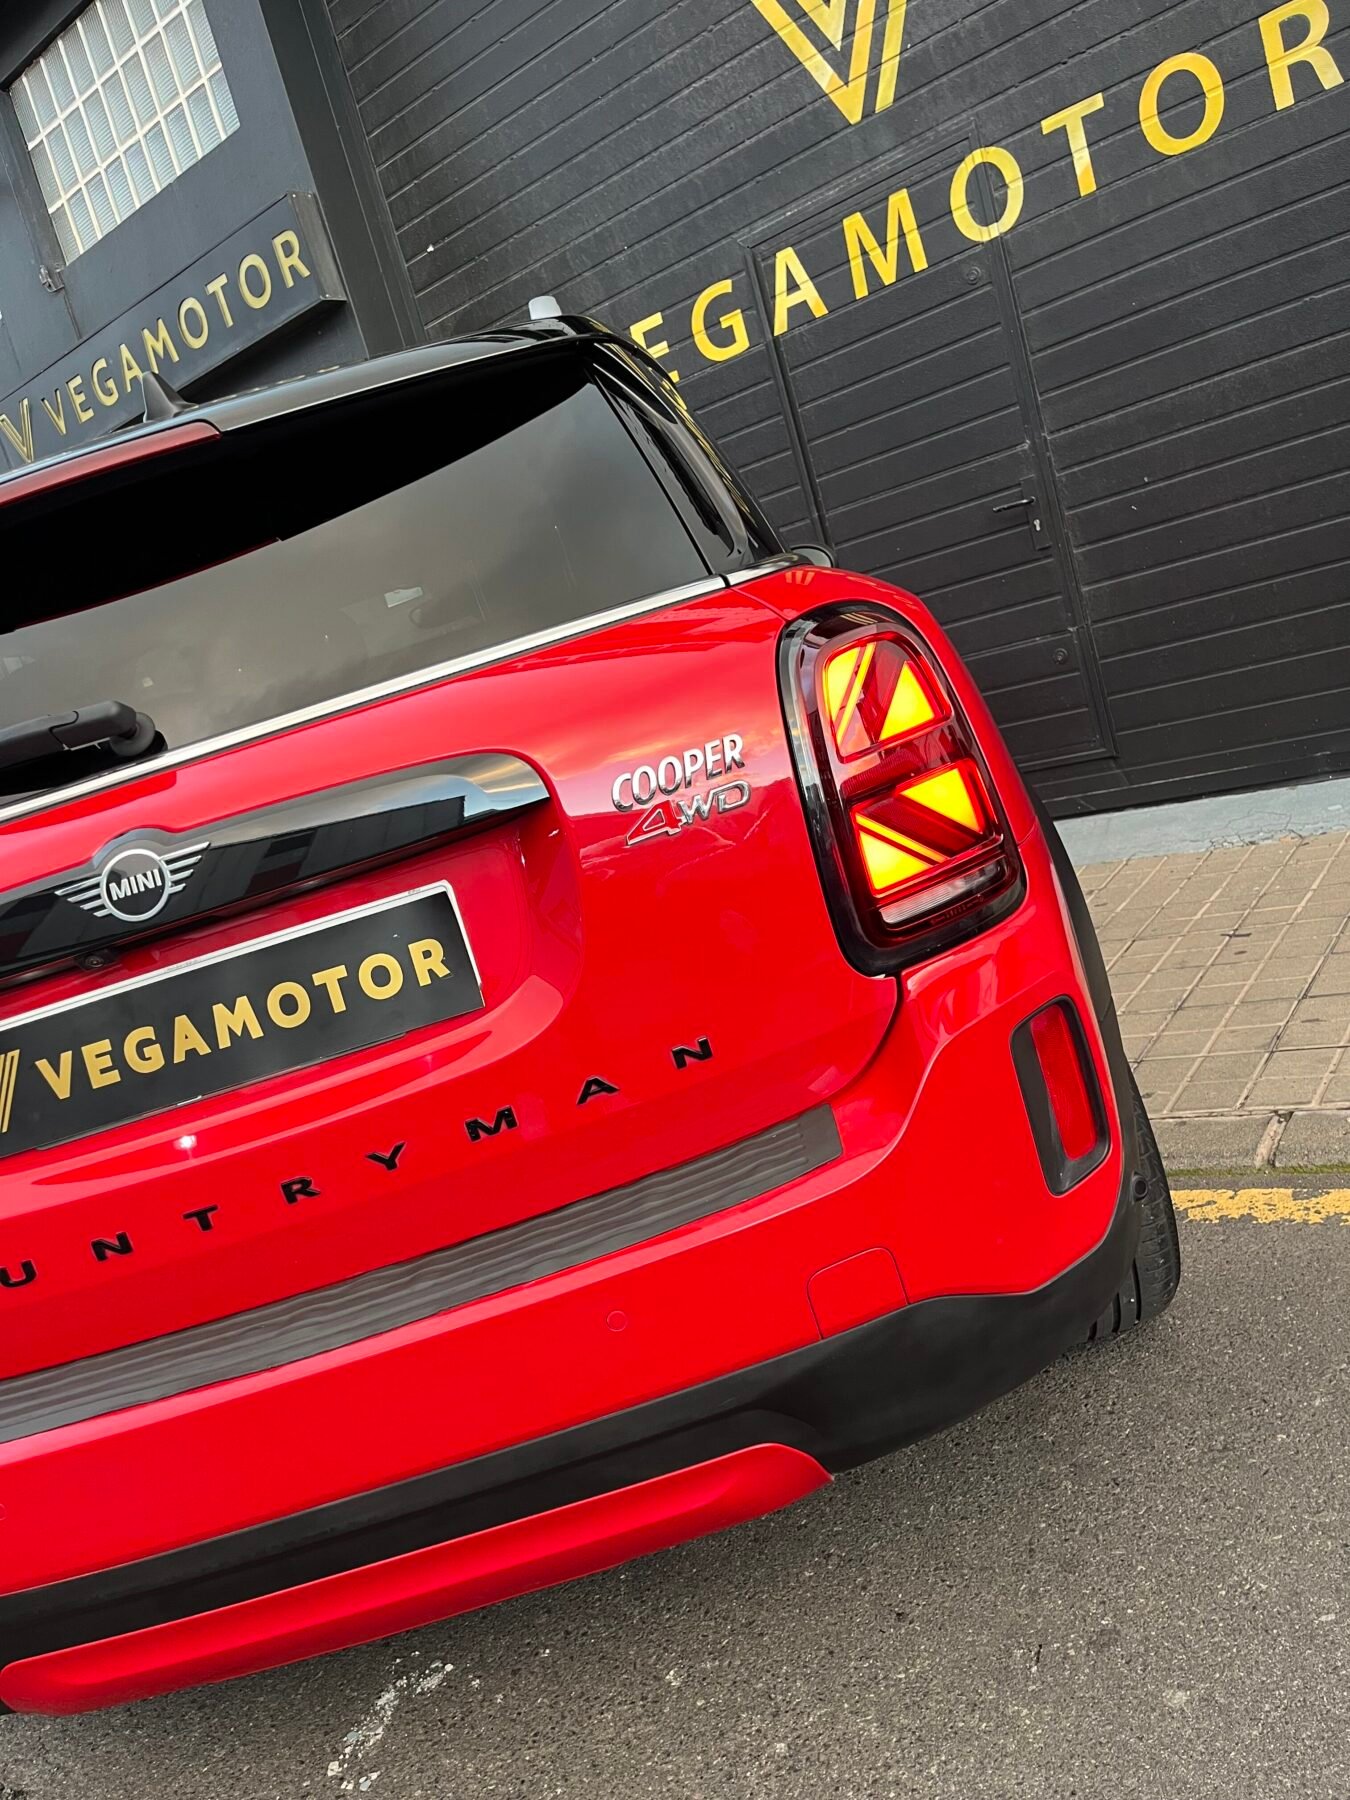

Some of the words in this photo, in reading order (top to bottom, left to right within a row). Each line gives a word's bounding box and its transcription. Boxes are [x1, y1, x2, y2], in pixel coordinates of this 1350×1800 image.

[40, 229, 312, 436] VEGAMOTOR
[611, 733, 746, 812] COOPER
[626, 779, 752, 846] 4WD
[108, 868, 163, 901] MINI
[35, 938, 452, 1100] VEGAMOTOR
